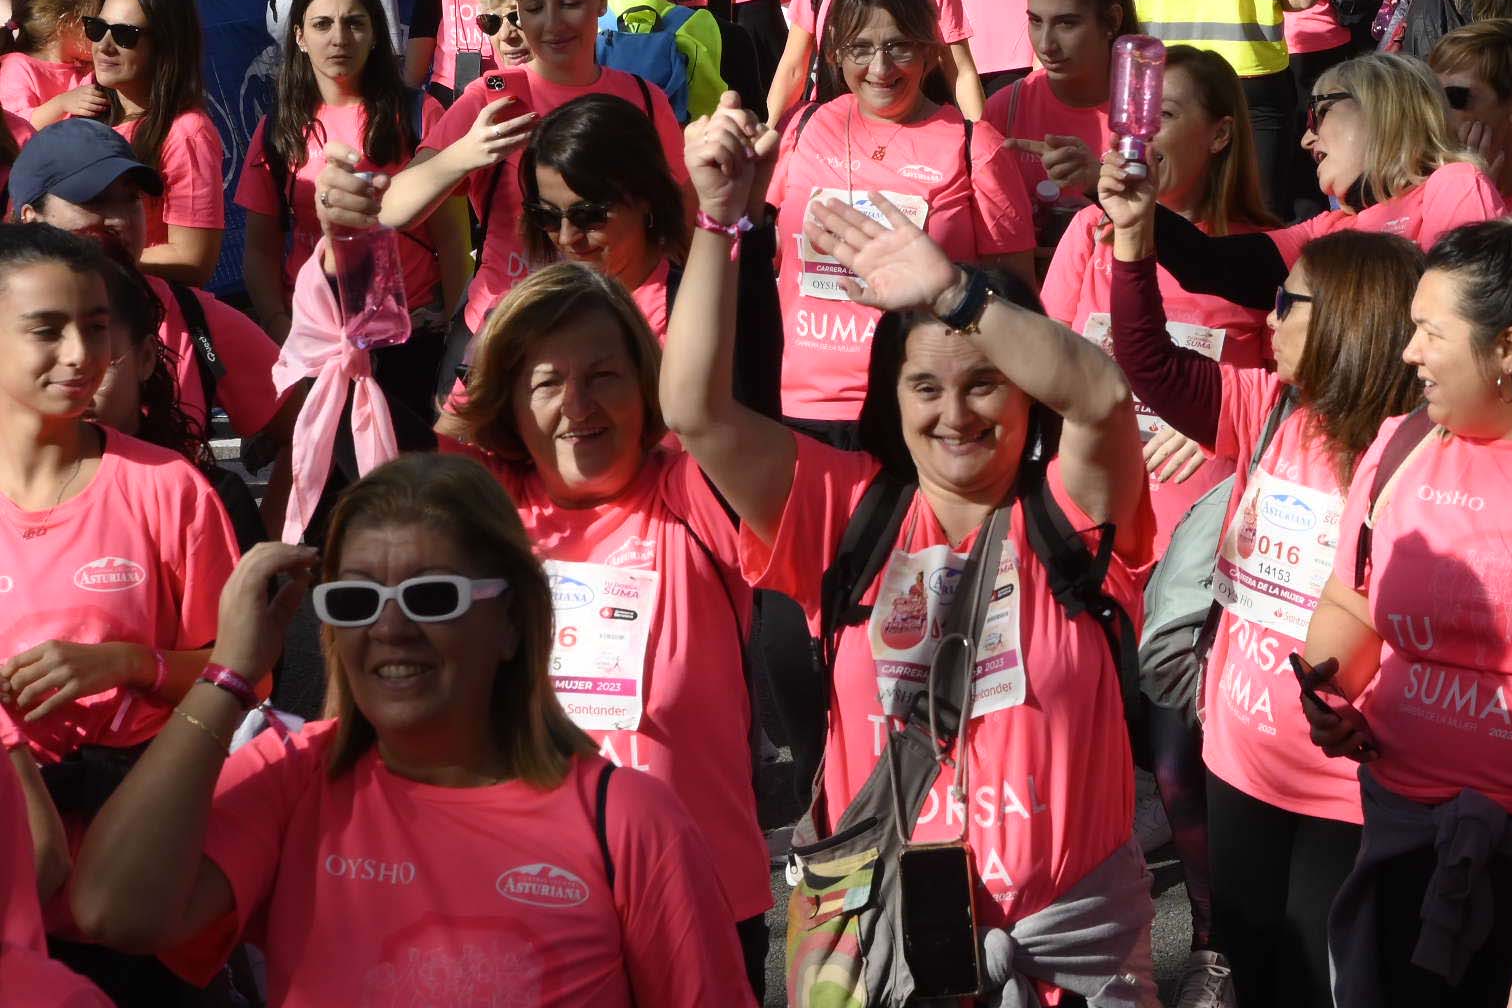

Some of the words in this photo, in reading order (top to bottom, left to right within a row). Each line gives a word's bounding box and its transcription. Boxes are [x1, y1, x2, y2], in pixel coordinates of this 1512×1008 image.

[816, 264, 848, 274] CARRERA
[796, 309, 878, 343] SUMA
[1417, 485, 1485, 512] OYSHO
[80, 567, 145, 587] ASTURIANA
[1258, 561, 1291, 584] 14153
[603, 587, 640, 600] SUMA
[1257, 582, 1269, 594] DE
[1269, 584, 1280, 596] LA
[1280, 588, 1305, 605] MUJER
[1307, 597, 1319, 608] 20
[1388, 612, 1434, 651] TU
[555, 679, 593, 690] MUJER
[596, 681, 622, 692] 2023
[1404, 663, 1512, 726] SUMA
[567, 703, 628, 716] Santander
[917, 775, 1048, 829] ORSAL
[325, 852, 417, 888] OYSHO
[502, 877, 588, 903] ASTURIANA
